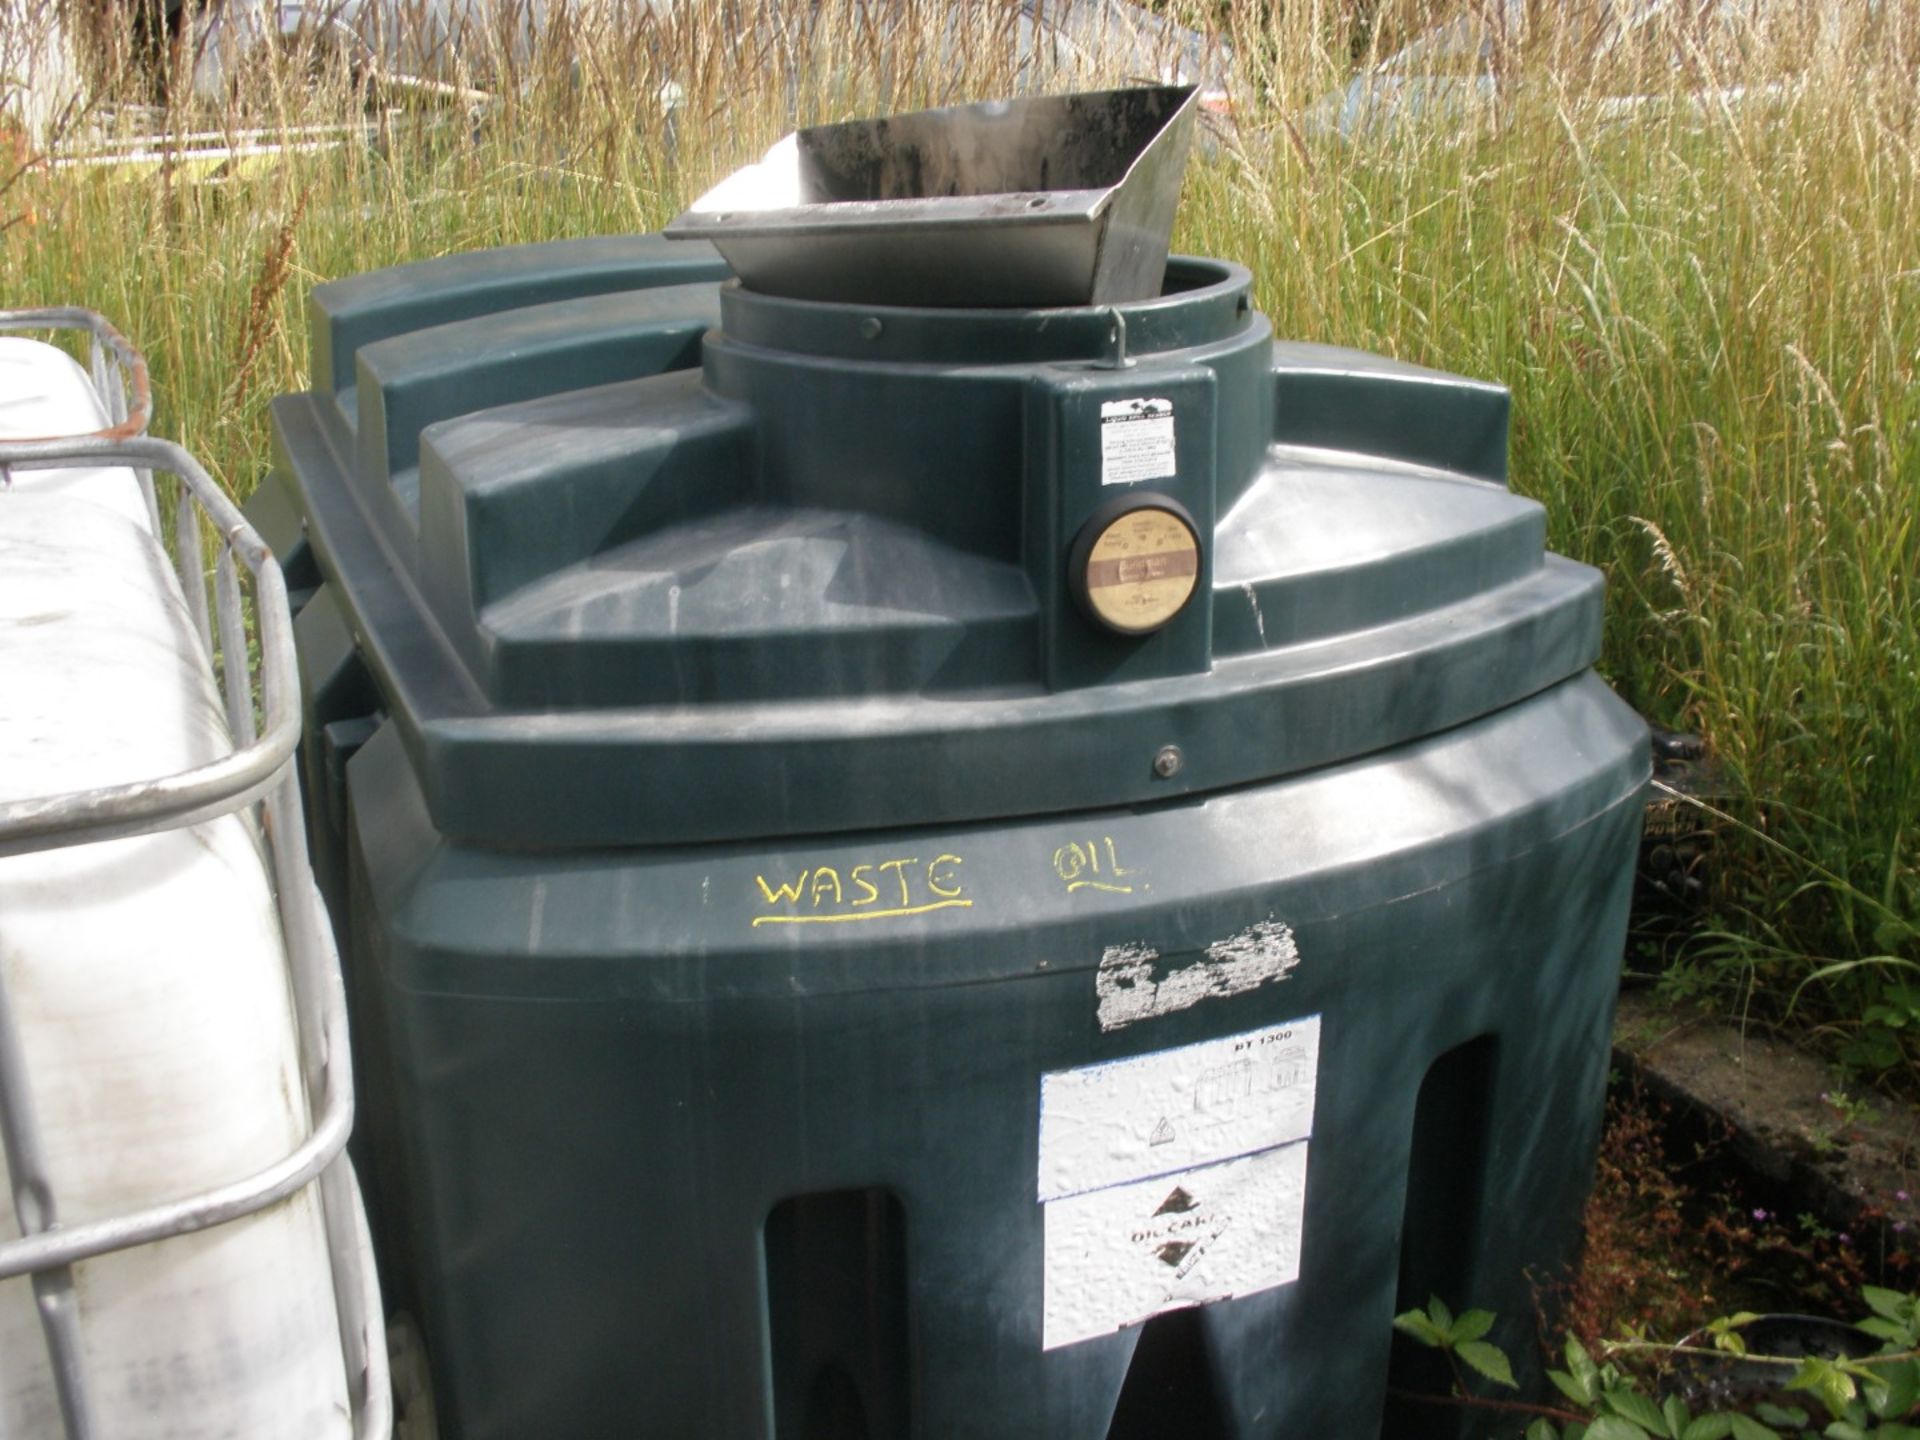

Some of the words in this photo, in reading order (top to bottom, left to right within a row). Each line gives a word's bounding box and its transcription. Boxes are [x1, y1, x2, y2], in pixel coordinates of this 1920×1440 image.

[756, 854, 963, 908] WASTE
[1053, 836, 1130, 880] OIL
[1259, 1030, 1293, 1045] 1300
